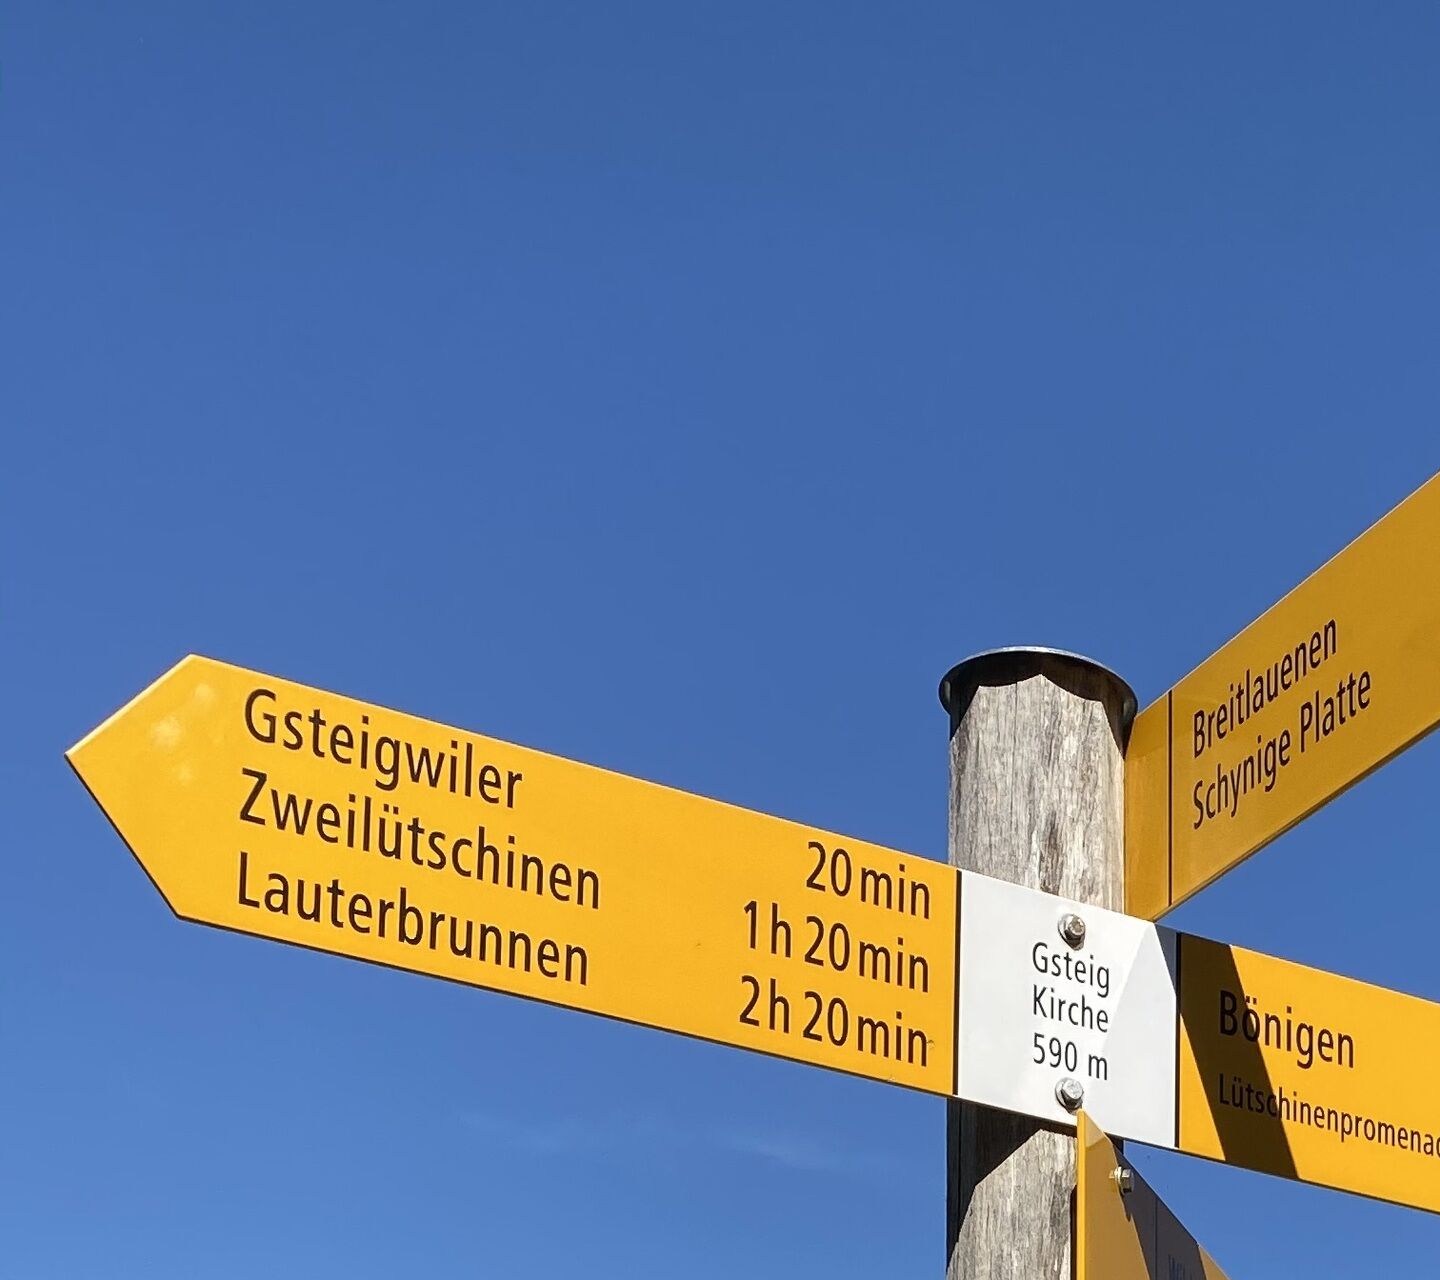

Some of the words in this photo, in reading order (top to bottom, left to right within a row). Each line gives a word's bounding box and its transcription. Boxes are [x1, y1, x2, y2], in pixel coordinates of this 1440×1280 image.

[244, 688, 523, 809] Gsteigwiler
[1193, 618, 1337, 759] Breitlauenen
[1193, 728, 1290, 830] Schynige
[1300, 671, 1371, 753] Platte
[239, 768, 600, 910] Zweilütschinen
[237, 851, 588, 987] Lauterbrunnen
[1032, 942, 1110, 999] Gsteig
[1033, 985, 1109, 1033] Kirche
[1033, 1032, 1078, 1073] 590
[1088, 1054, 1108, 1081] m
[1219, 989, 1355, 1069] Bönigen
